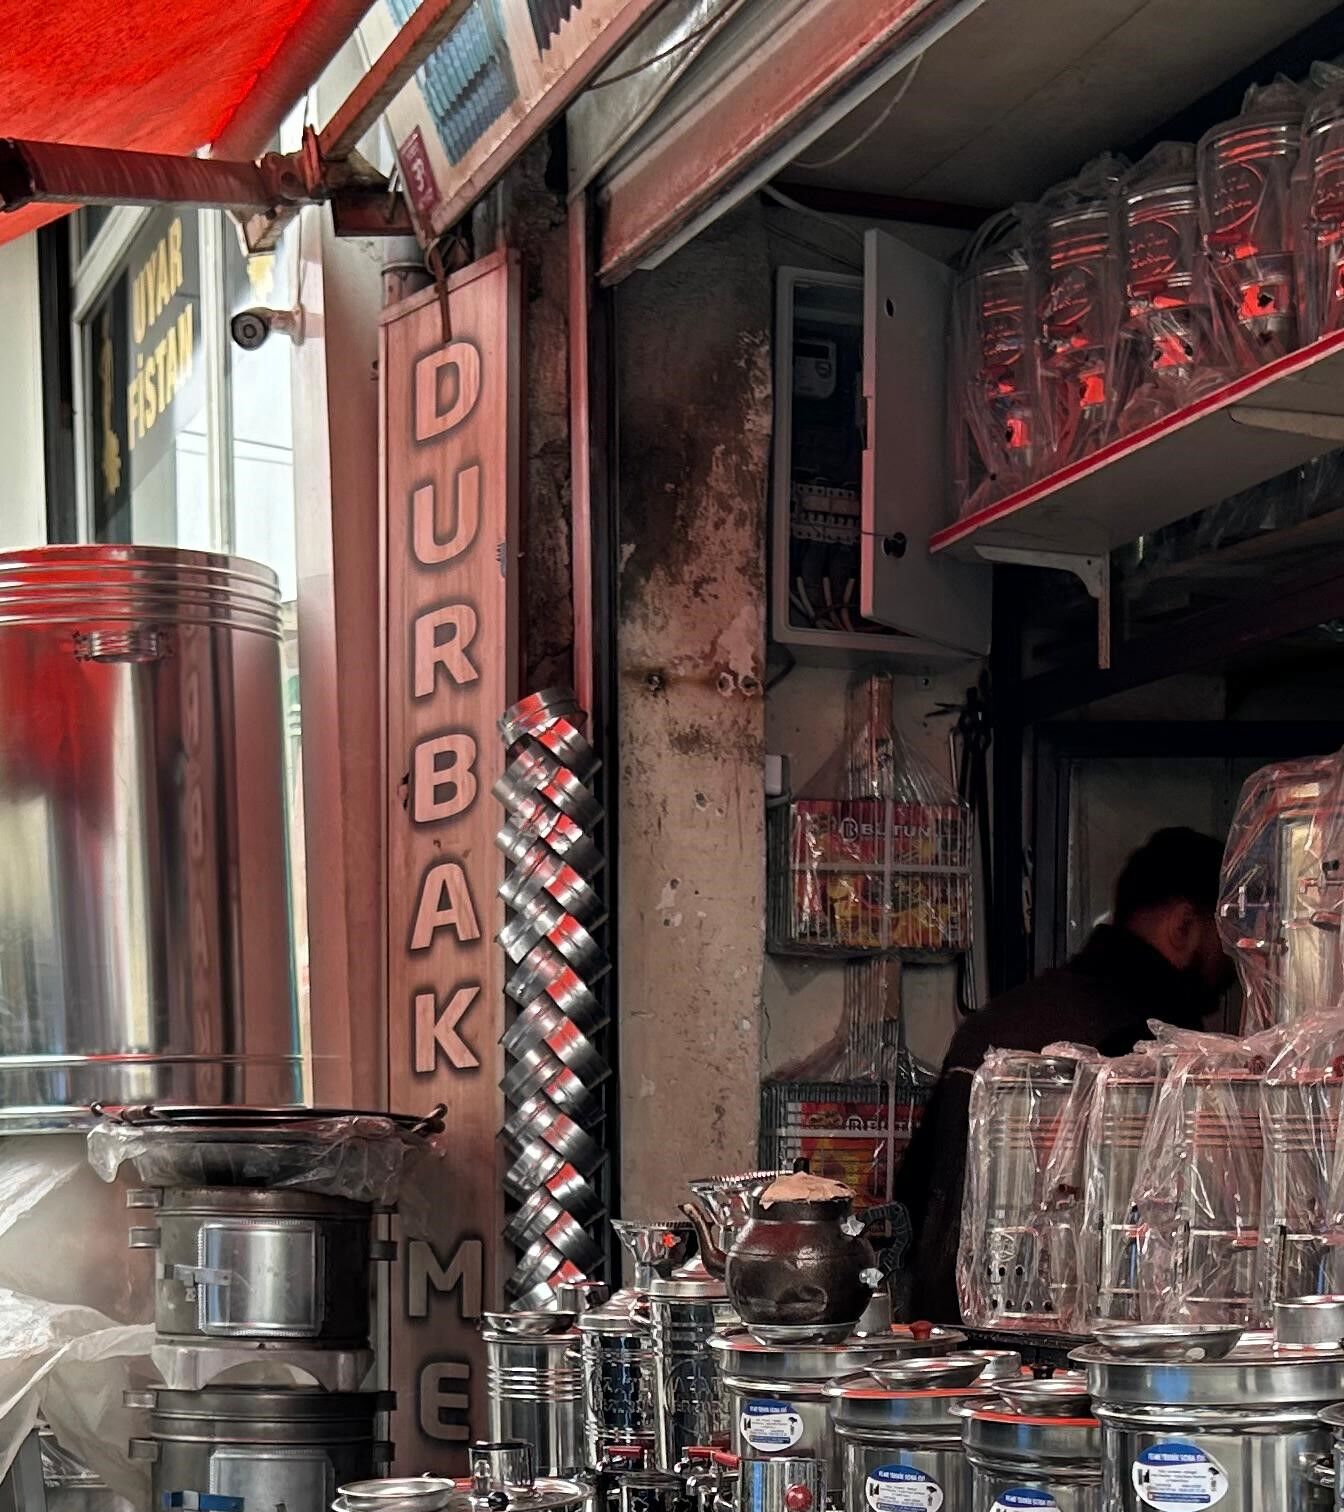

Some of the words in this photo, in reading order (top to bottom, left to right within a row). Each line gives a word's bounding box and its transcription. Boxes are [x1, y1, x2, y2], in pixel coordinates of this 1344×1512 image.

[133, 217, 184, 344] UYAR
[128, 303, 194, 451] FİSTAN
[411, 341, 482, 1073] DURBAK
[408, 1239, 483, 1440] ME
